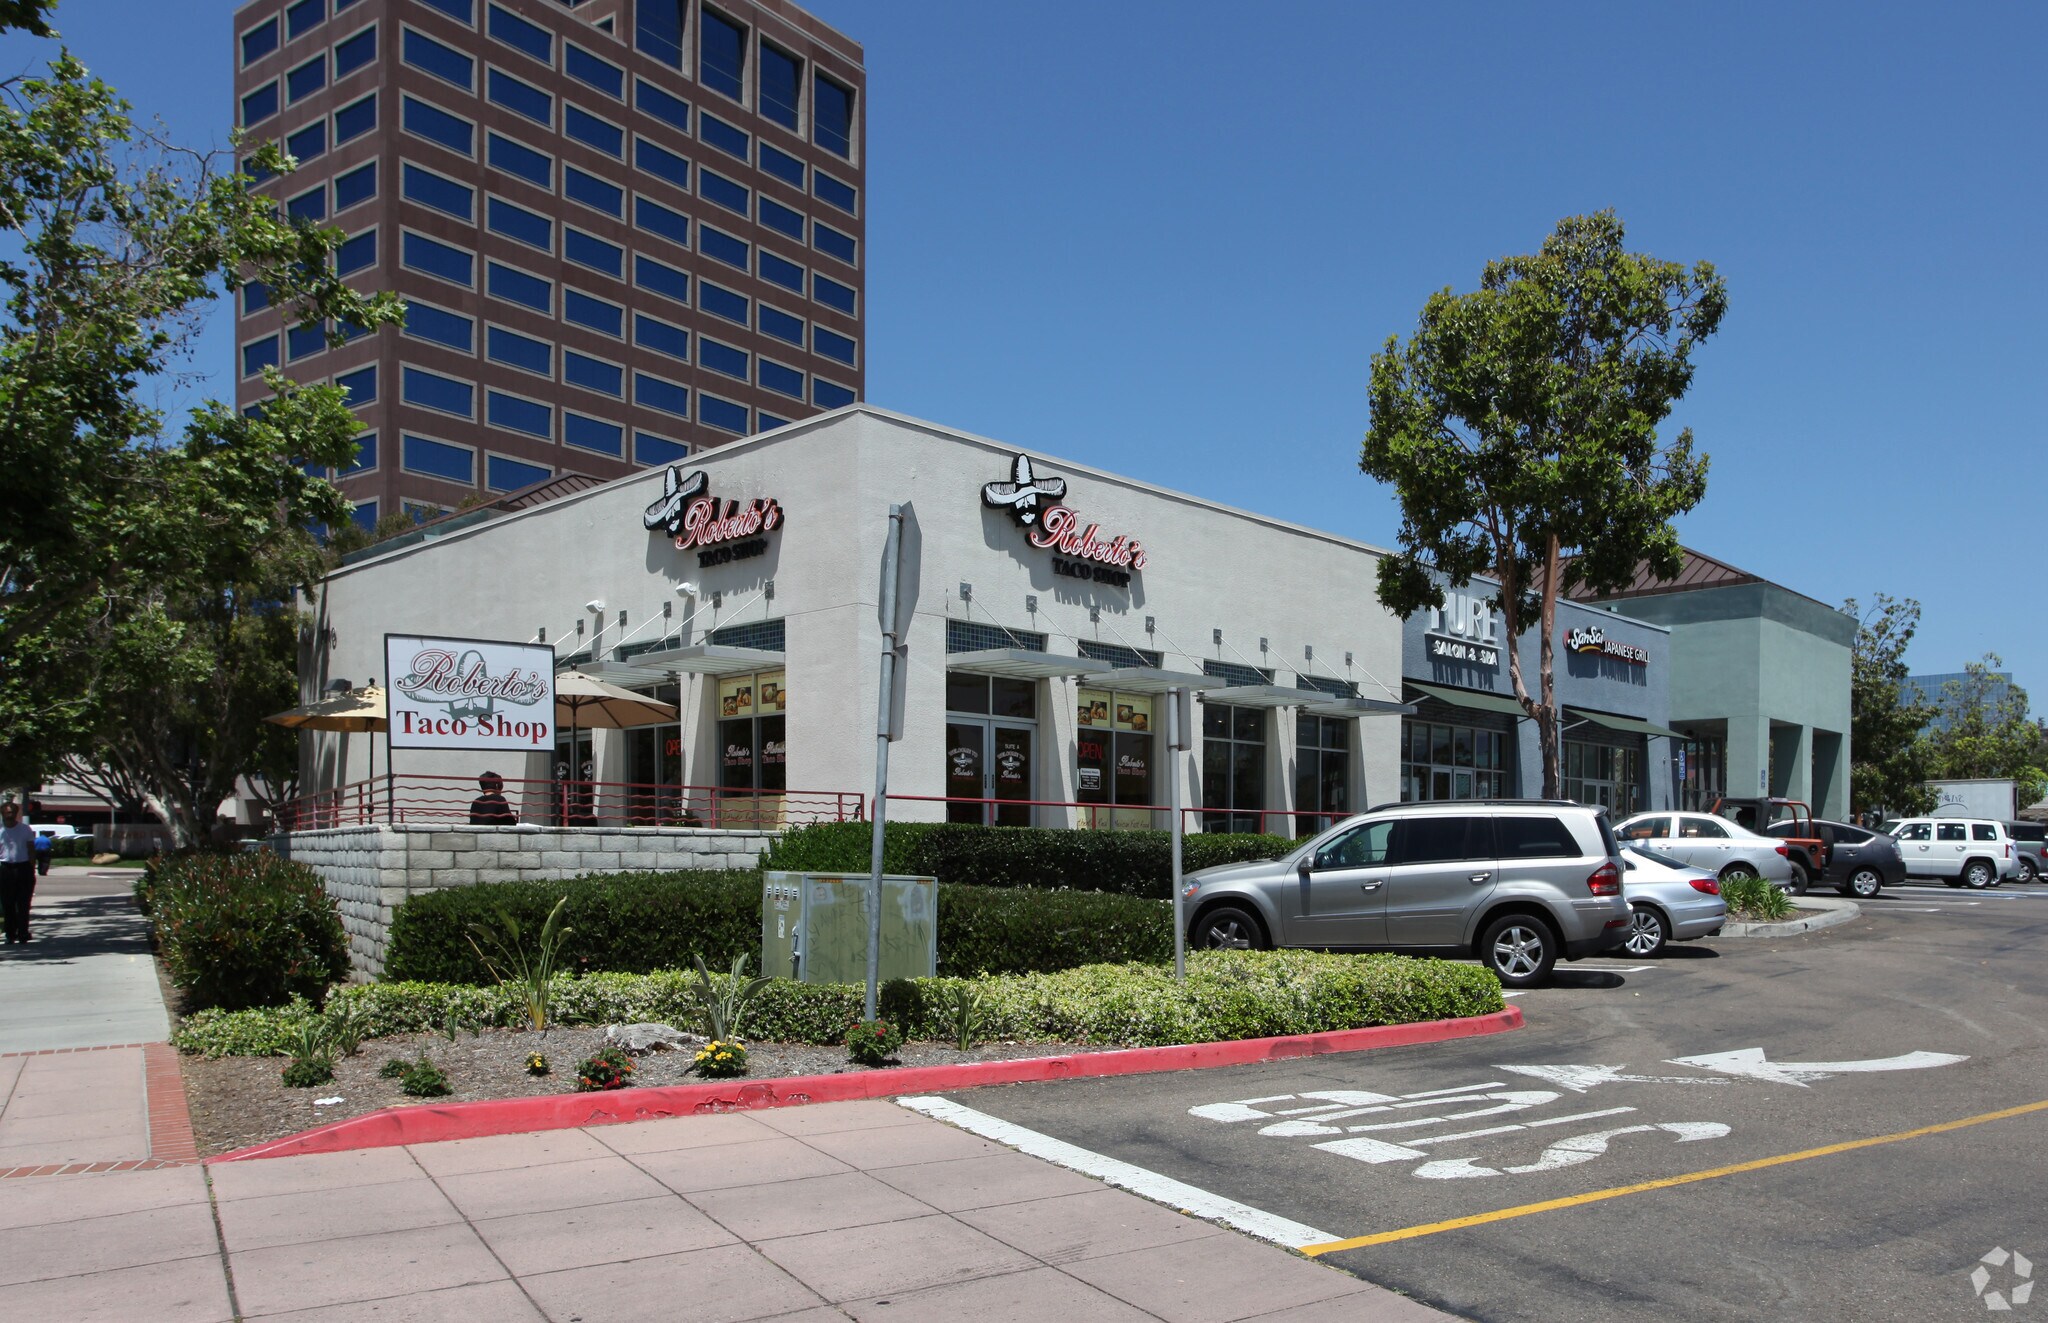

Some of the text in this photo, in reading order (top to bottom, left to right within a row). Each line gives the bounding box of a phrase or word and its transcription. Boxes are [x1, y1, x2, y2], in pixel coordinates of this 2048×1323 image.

[675, 497, 784, 550] Roberto's
[1027, 505, 1148, 570] Roberto's
[698, 547, 732, 568] TACO
[1052, 556, 1131, 588] TACO SHOP
[1430, 589, 1498, 642] PURE
[1432, 639, 1498, 666] SALON & SPA
[1567, 625, 1604, 650] SanSai
[1603, 640, 1651, 663] JAPANESE GRILL
[394, 648, 549, 699] Roberto's
[396, 710, 548, 744] Taco Shop
[665, 739, 681, 756] OPE
